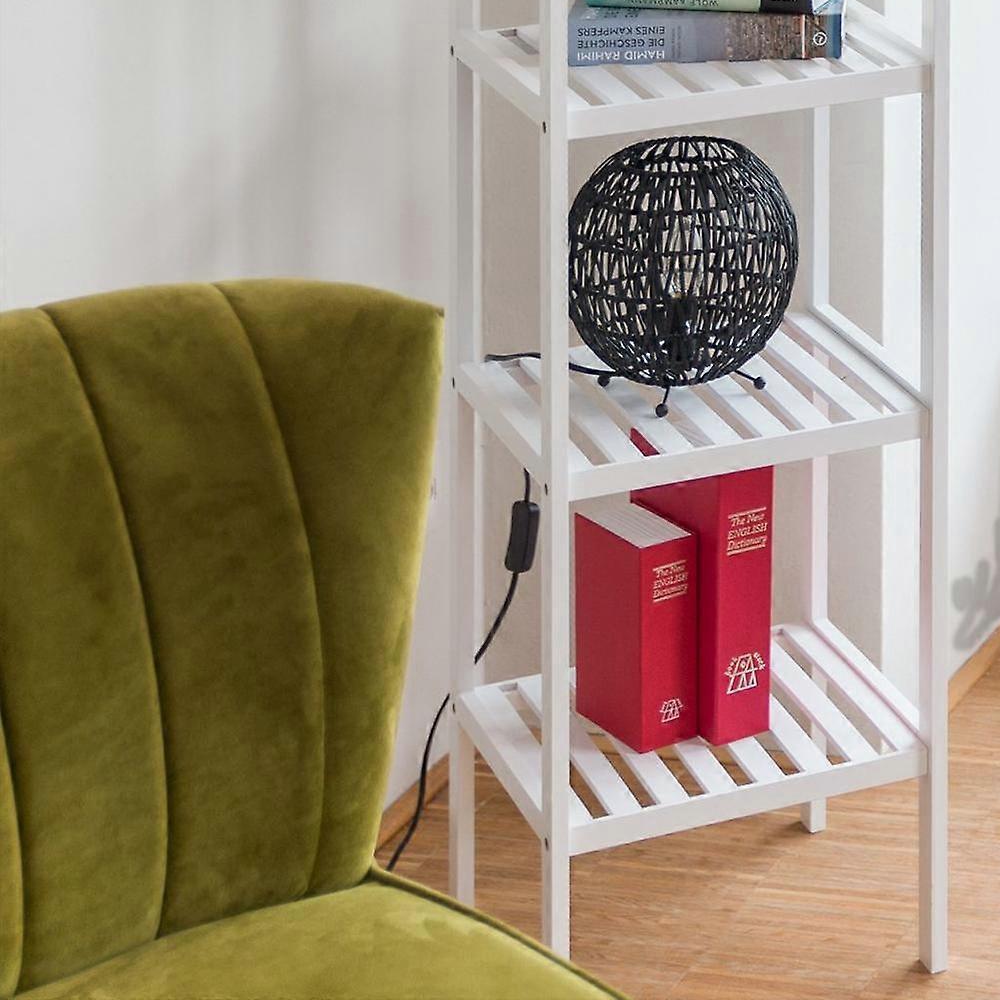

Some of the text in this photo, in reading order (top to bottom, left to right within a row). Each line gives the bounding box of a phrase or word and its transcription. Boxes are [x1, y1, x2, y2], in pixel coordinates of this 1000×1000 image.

[690, 0, 719, 7] WOLF
[636, 26, 665, 36] EINES
[577, 38, 665, 49] DIE GESCHICHTE
[577, 50, 665, 61] HAMID RAHIMI
[730, 516, 745, 527] The
[728, 522, 768, 540] ENGLISH
[728, 535, 767, 550] Dictionary
